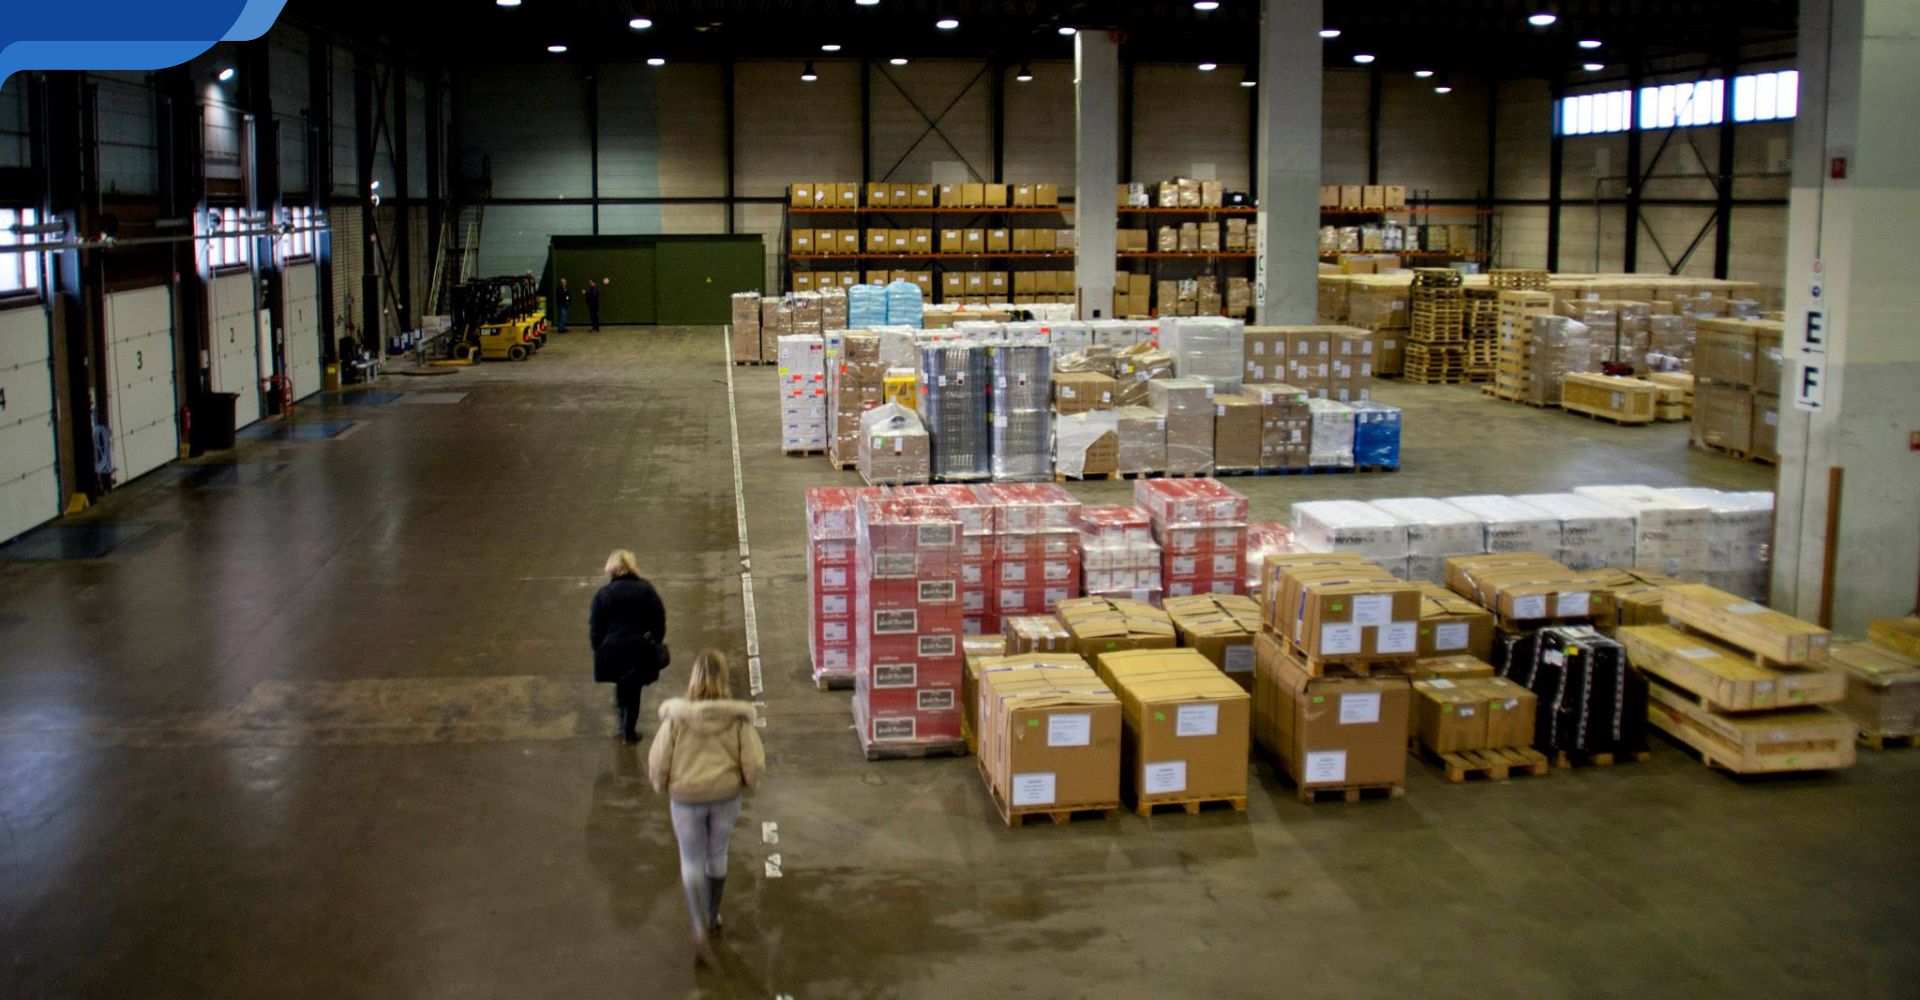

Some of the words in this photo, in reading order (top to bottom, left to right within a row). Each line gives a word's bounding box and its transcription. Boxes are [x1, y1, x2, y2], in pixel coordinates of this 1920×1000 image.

[229, 327, 235, 343] 2
[1807, 312, 1822, 344] E
[136, 350, 143, 370] 3
[1803, 367, 1819, 397] F
